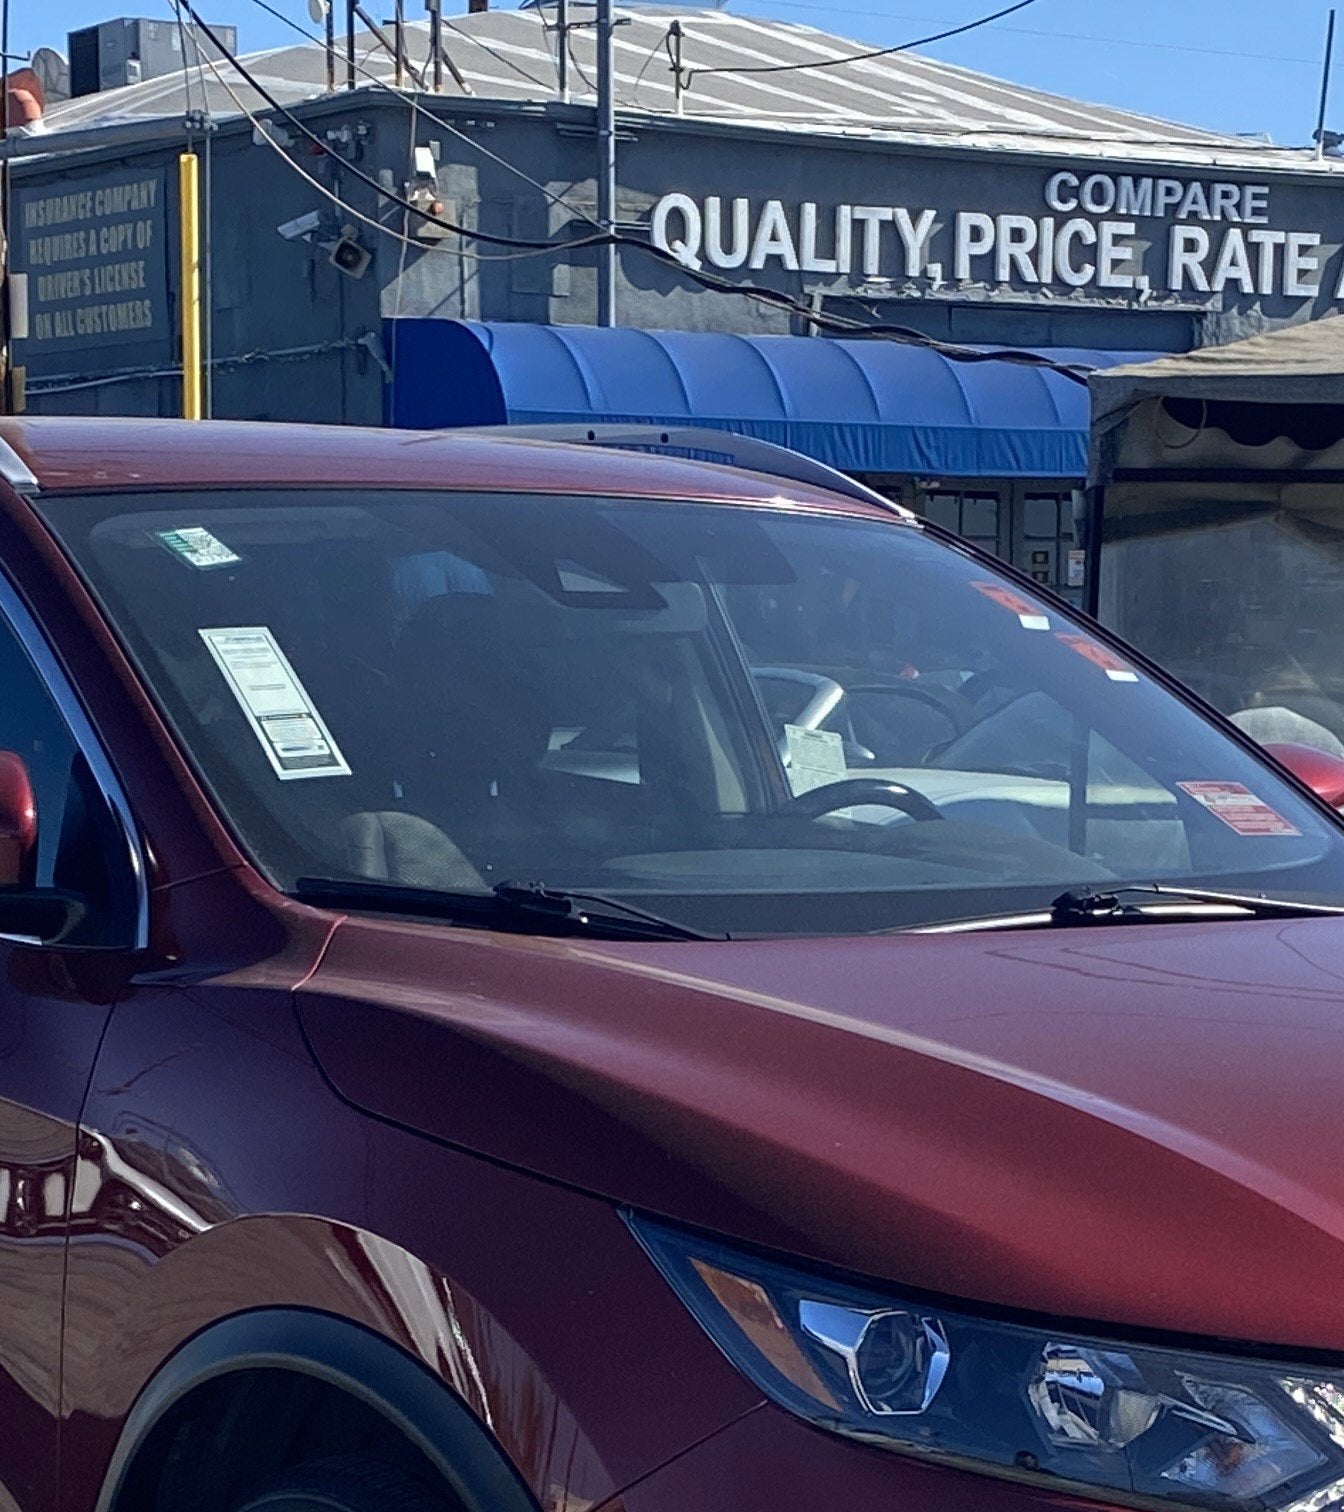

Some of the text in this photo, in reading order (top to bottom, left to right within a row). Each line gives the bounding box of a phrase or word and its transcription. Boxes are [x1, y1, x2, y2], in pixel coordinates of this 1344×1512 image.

[25, 178, 157, 228] INSURANCE COMPANY
[1045, 171, 1269, 224] COMPARE
[29, 219, 153, 266] REQUIRES A COPY OF
[651, 192, 944, 292] QUALITY,
[955, 211, 1149, 302] PRICE,
[1168, 224, 1321, 297] RATE
[38, 260, 146, 302] DRIVER'S LICENSE
[35, 299, 152, 340] ON ALL CUSTOMERS
